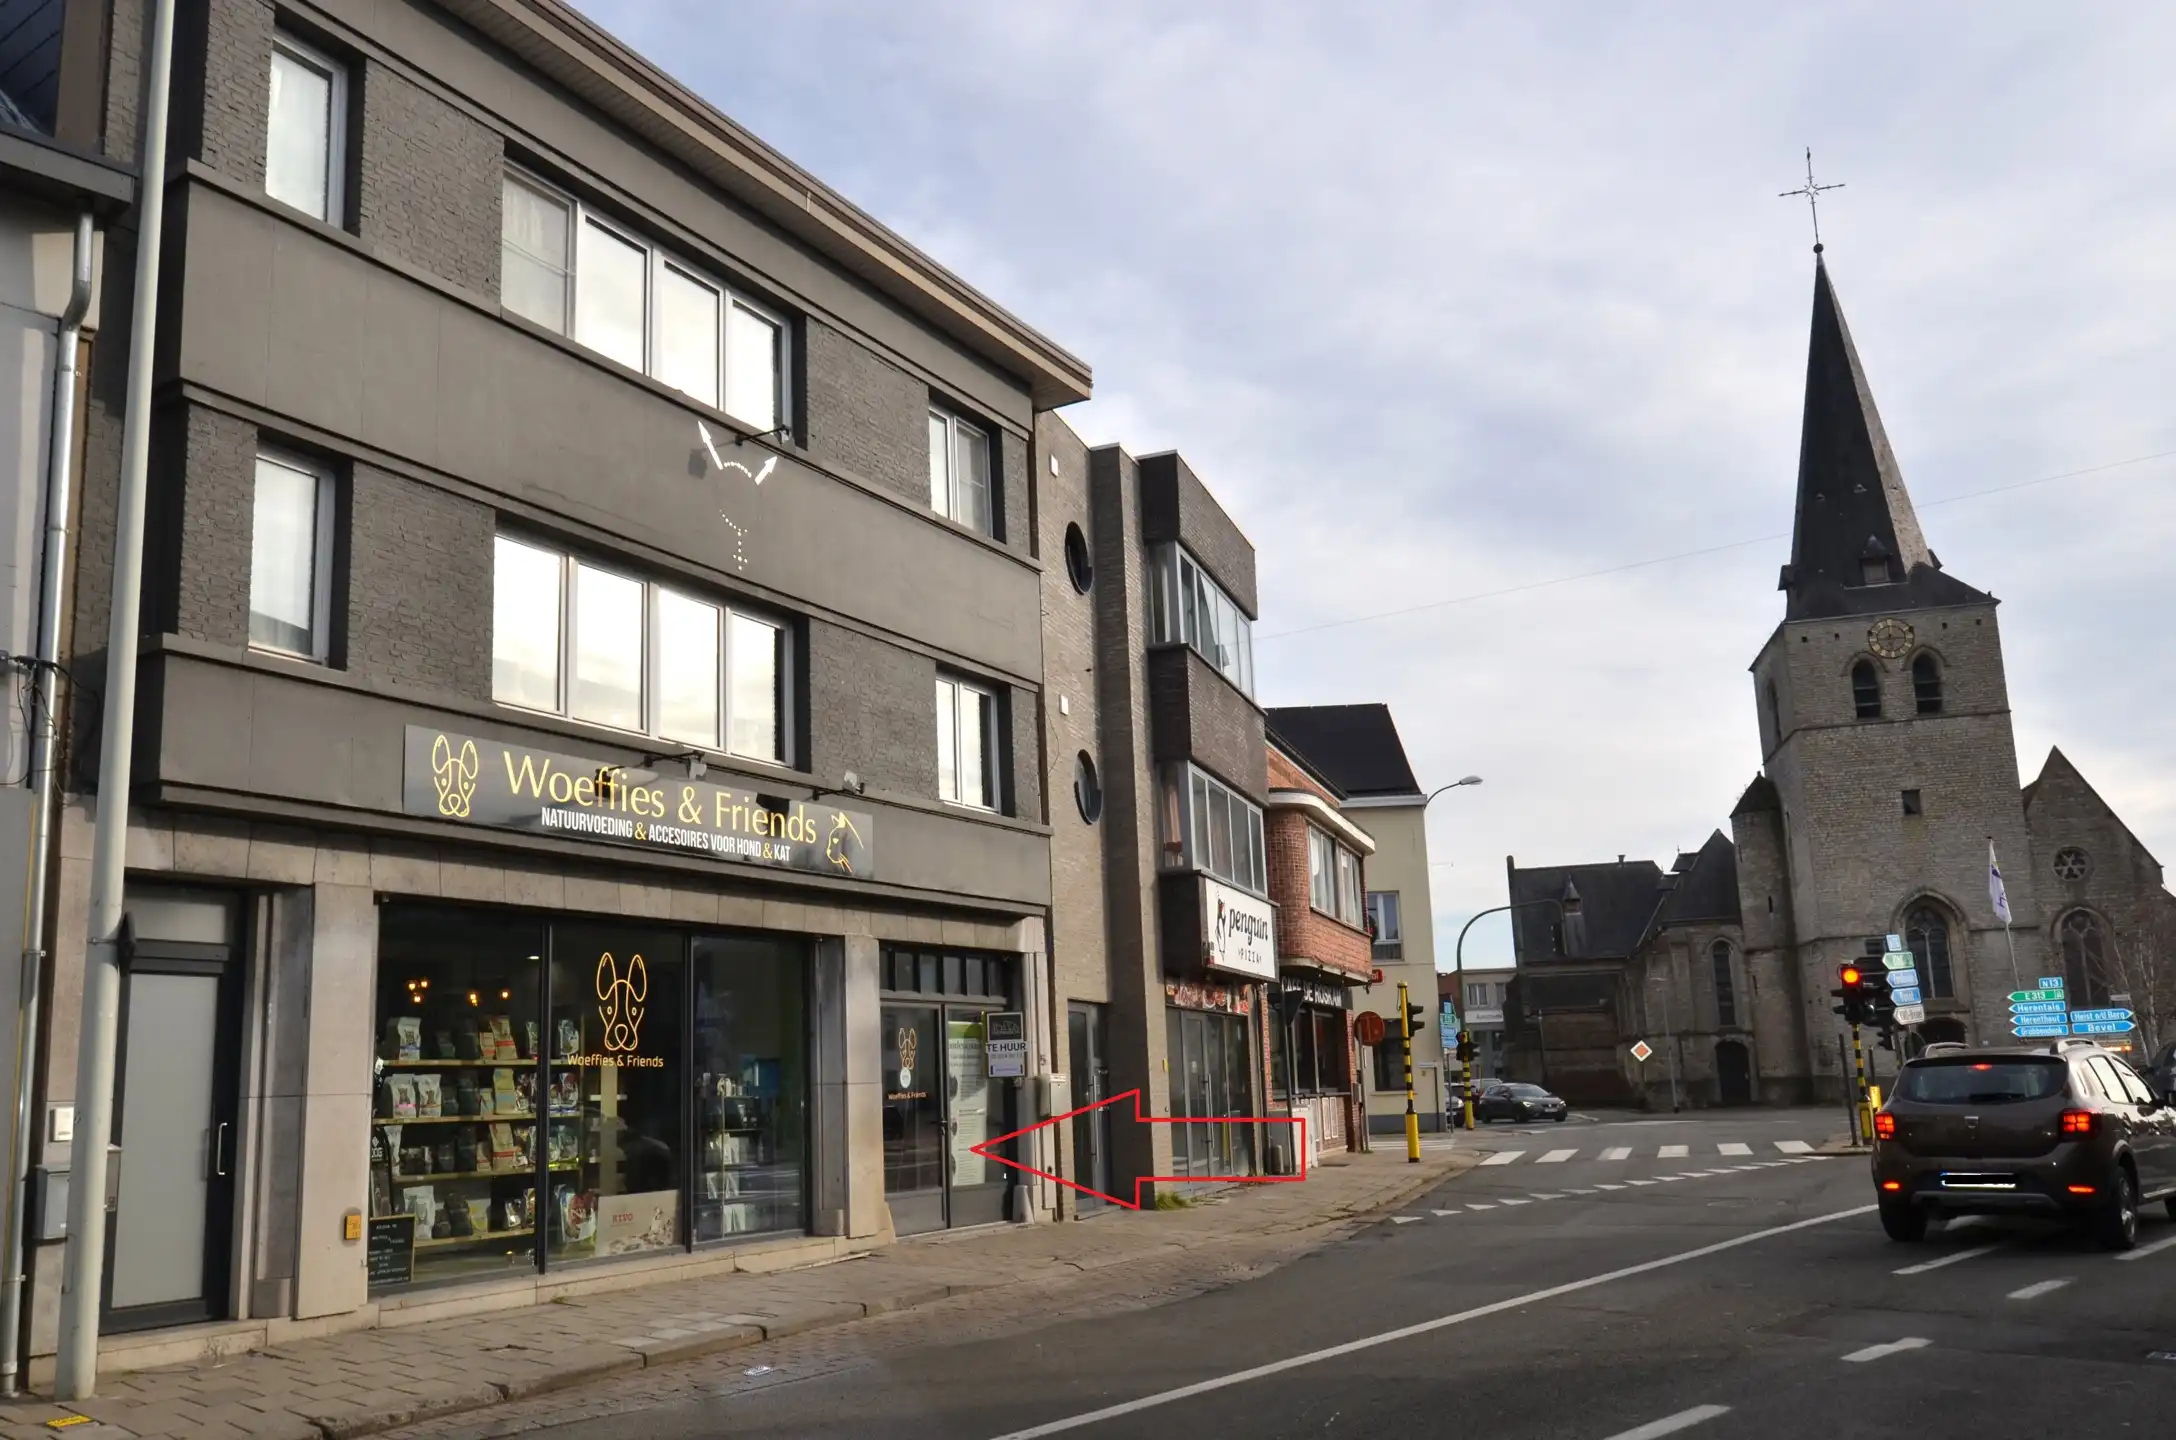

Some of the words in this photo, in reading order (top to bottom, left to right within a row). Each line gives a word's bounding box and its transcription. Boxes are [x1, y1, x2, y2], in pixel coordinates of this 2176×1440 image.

[503, 751, 665, 818] Woeffies
[678, 786, 702, 825] &
[716, 791, 817, 844] Friends
[541, 807, 633, 838] NATUURVOEDING
[634, 822, 646, 840] &
[648, 823, 709, 850] ACCESOIRES
[711, 833, 735, 853] VOOR
[736, 839, 761, 857] HOND
[763, 842, 773, 859] &
[774, 845, 790, 862] KAT
[1229, 908, 1268, 946] penguin
[2017, 1003, 2061, 1012] Herentals
[2087, 1022, 2117, 1032] Bevel
[987, 1043, 999, 1052] TE
[1000, 1042, 1026, 1052] HUUR
[567, 1053, 614, 1066] Woeffies
[616, 1055, 624, 1067] &
[627, 1055, 664, 1067] Friends
